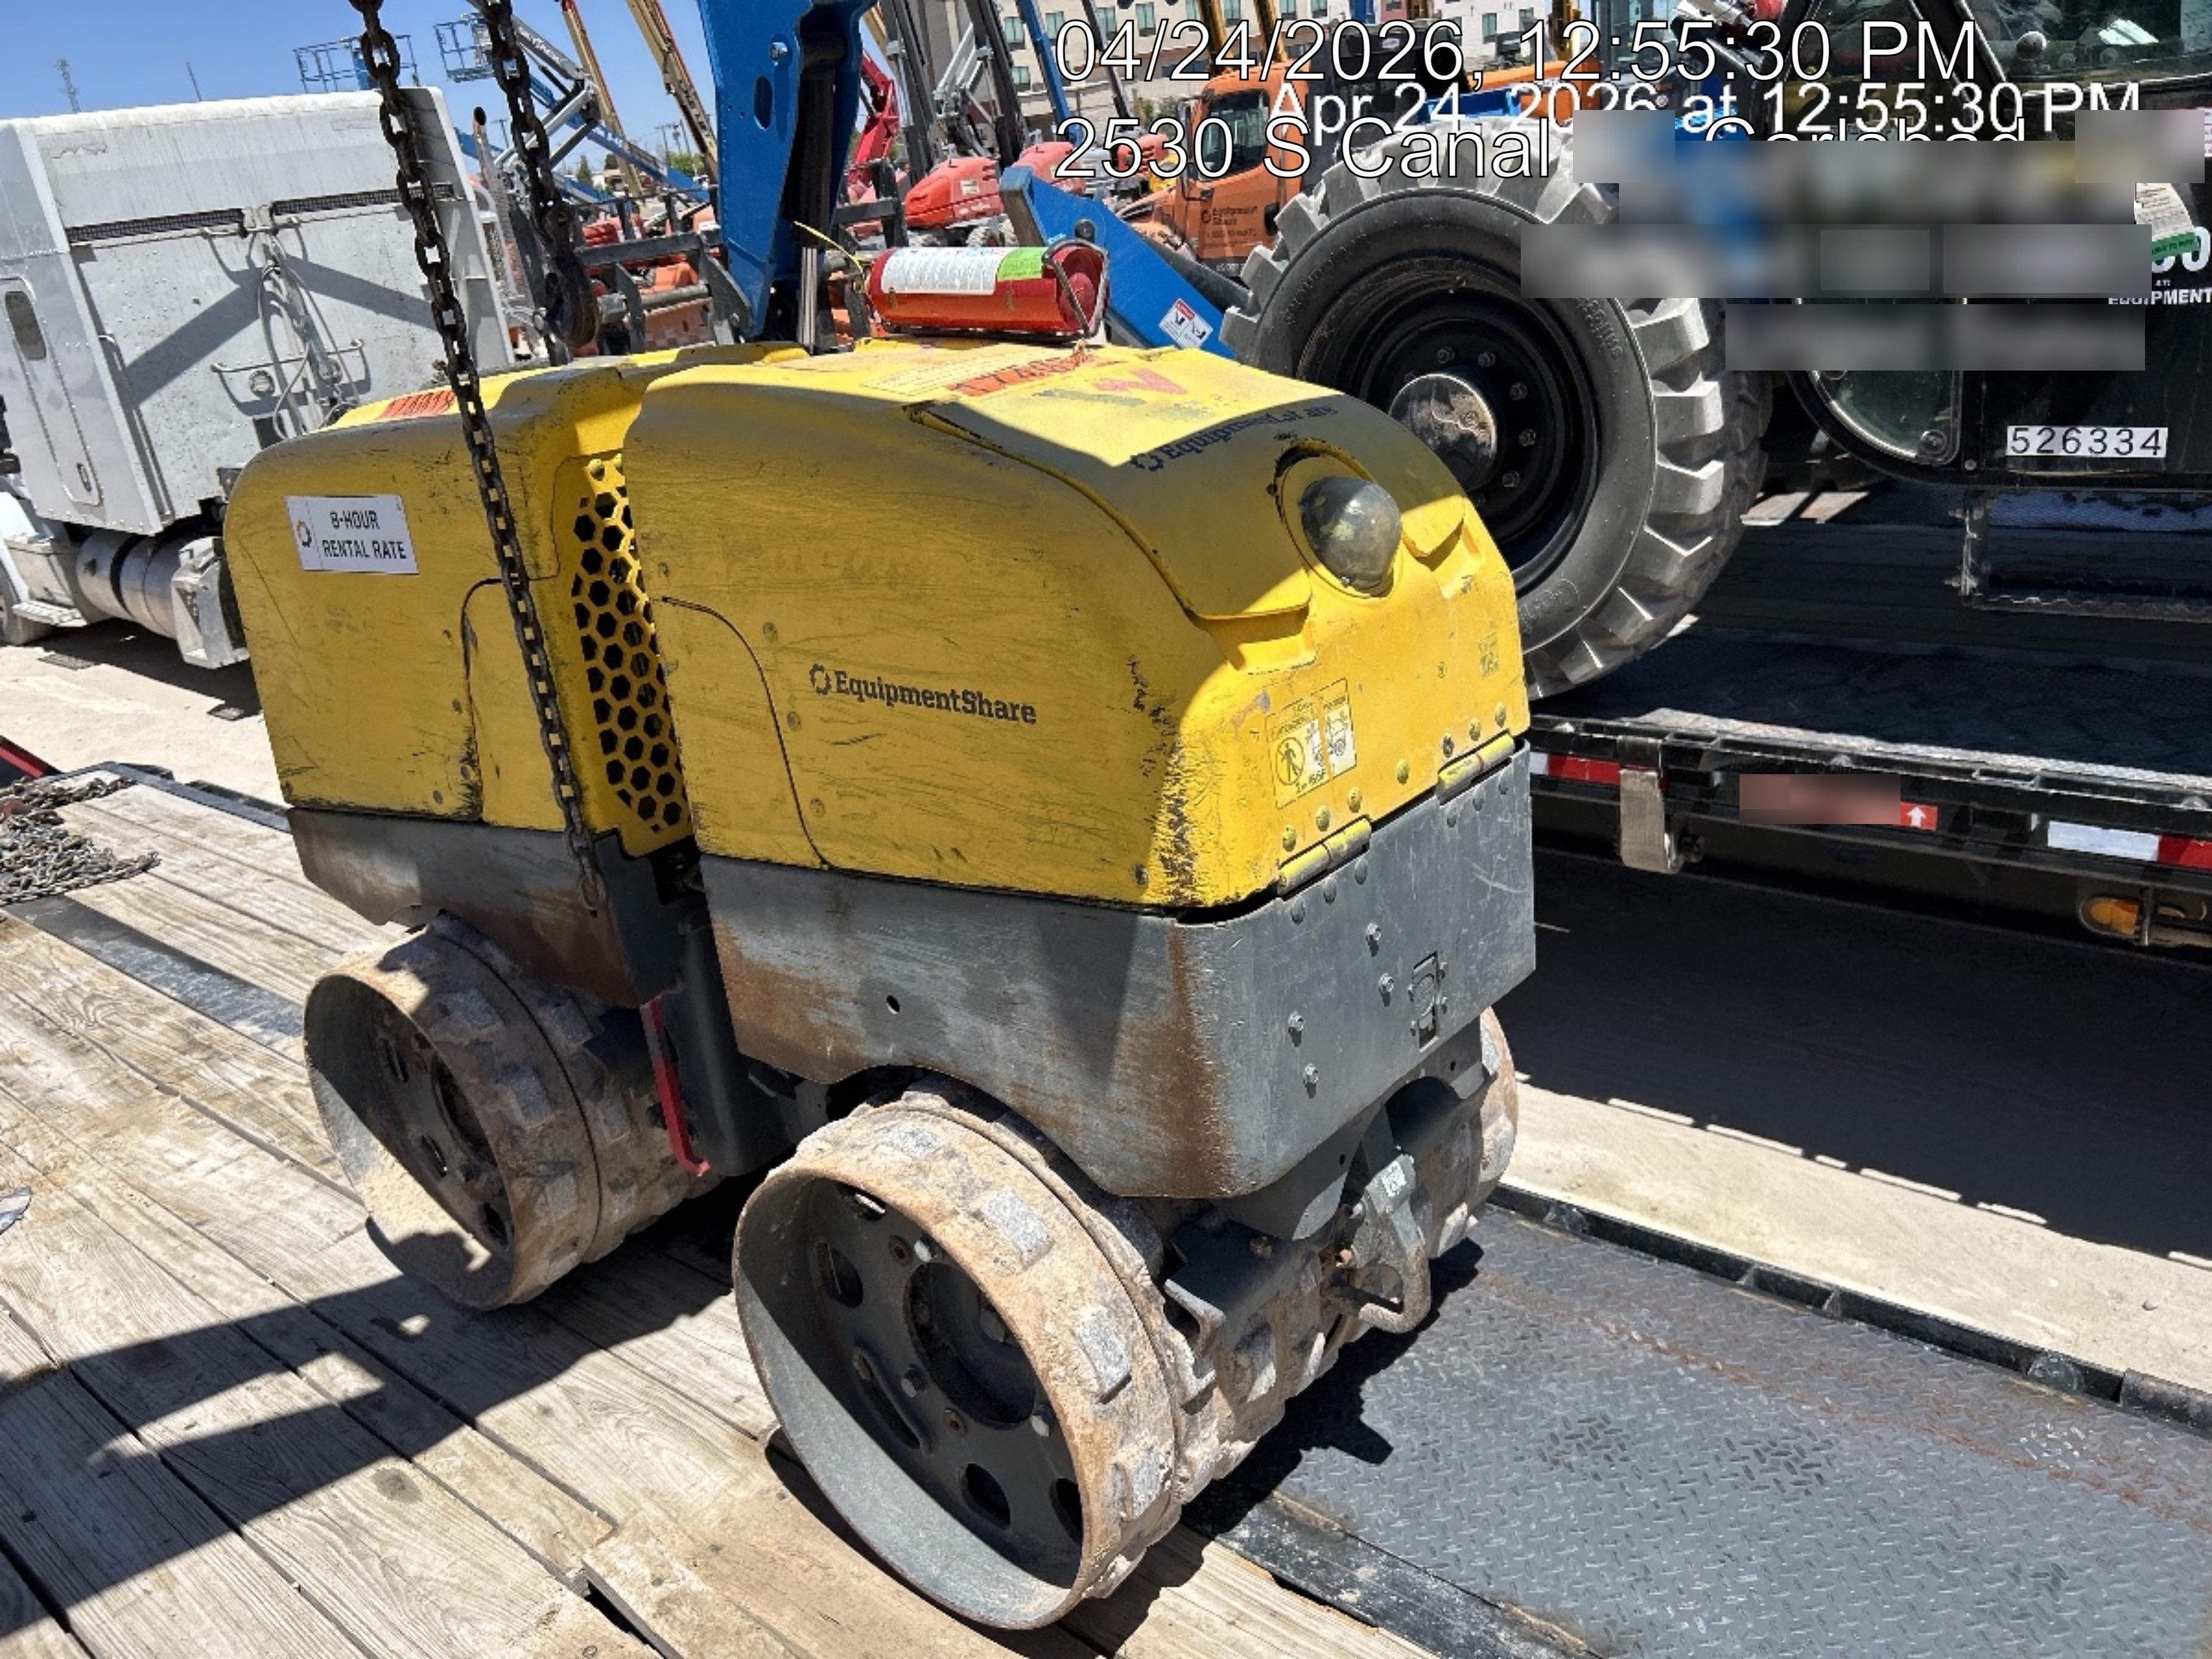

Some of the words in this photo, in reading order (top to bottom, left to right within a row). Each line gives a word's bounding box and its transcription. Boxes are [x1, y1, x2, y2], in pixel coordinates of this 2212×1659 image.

[2010, 426, 2161, 456] 526334
[329, 510, 380, 530] 8-HOUR
[321, 539, 371, 558] RENTAL
[372, 539, 407, 559] RATE
[834, 670, 1037, 725] EquipmentShare
